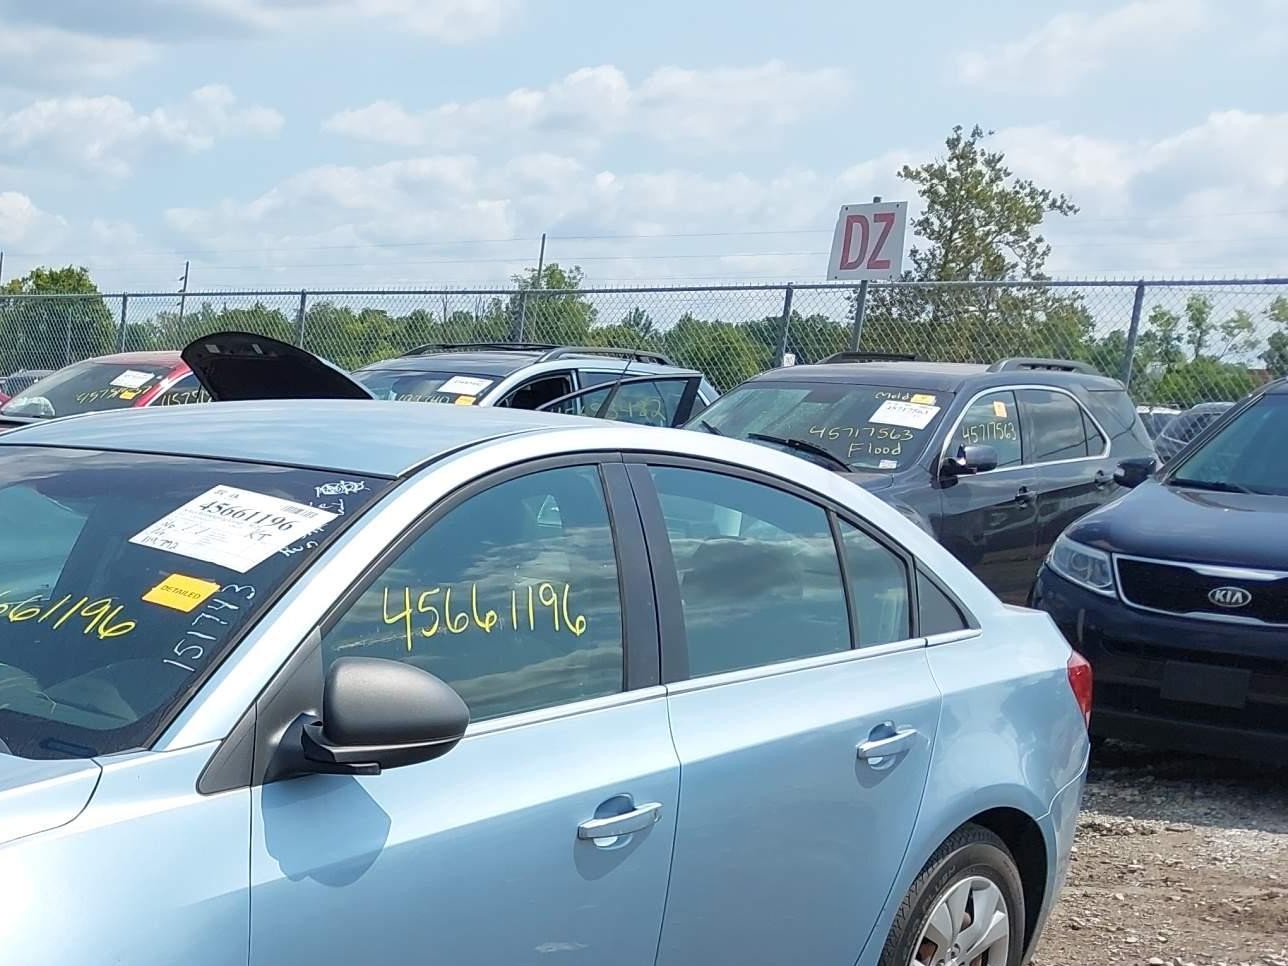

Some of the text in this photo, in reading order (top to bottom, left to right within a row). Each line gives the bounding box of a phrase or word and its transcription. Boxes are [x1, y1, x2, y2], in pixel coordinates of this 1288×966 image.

[839, 212, 896, 271] DZ
[809, 426, 914, 442] 45717563
[962, 421, 1017, 446] 45717563
[848, 443, 901, 458] Flood
[199, 500, 300, 532] 45661196
[160, 584, 201, 601] DETAILED
[1213, 589, 1244, 604] KIA
[383, 582, 588, 651] 45661196
